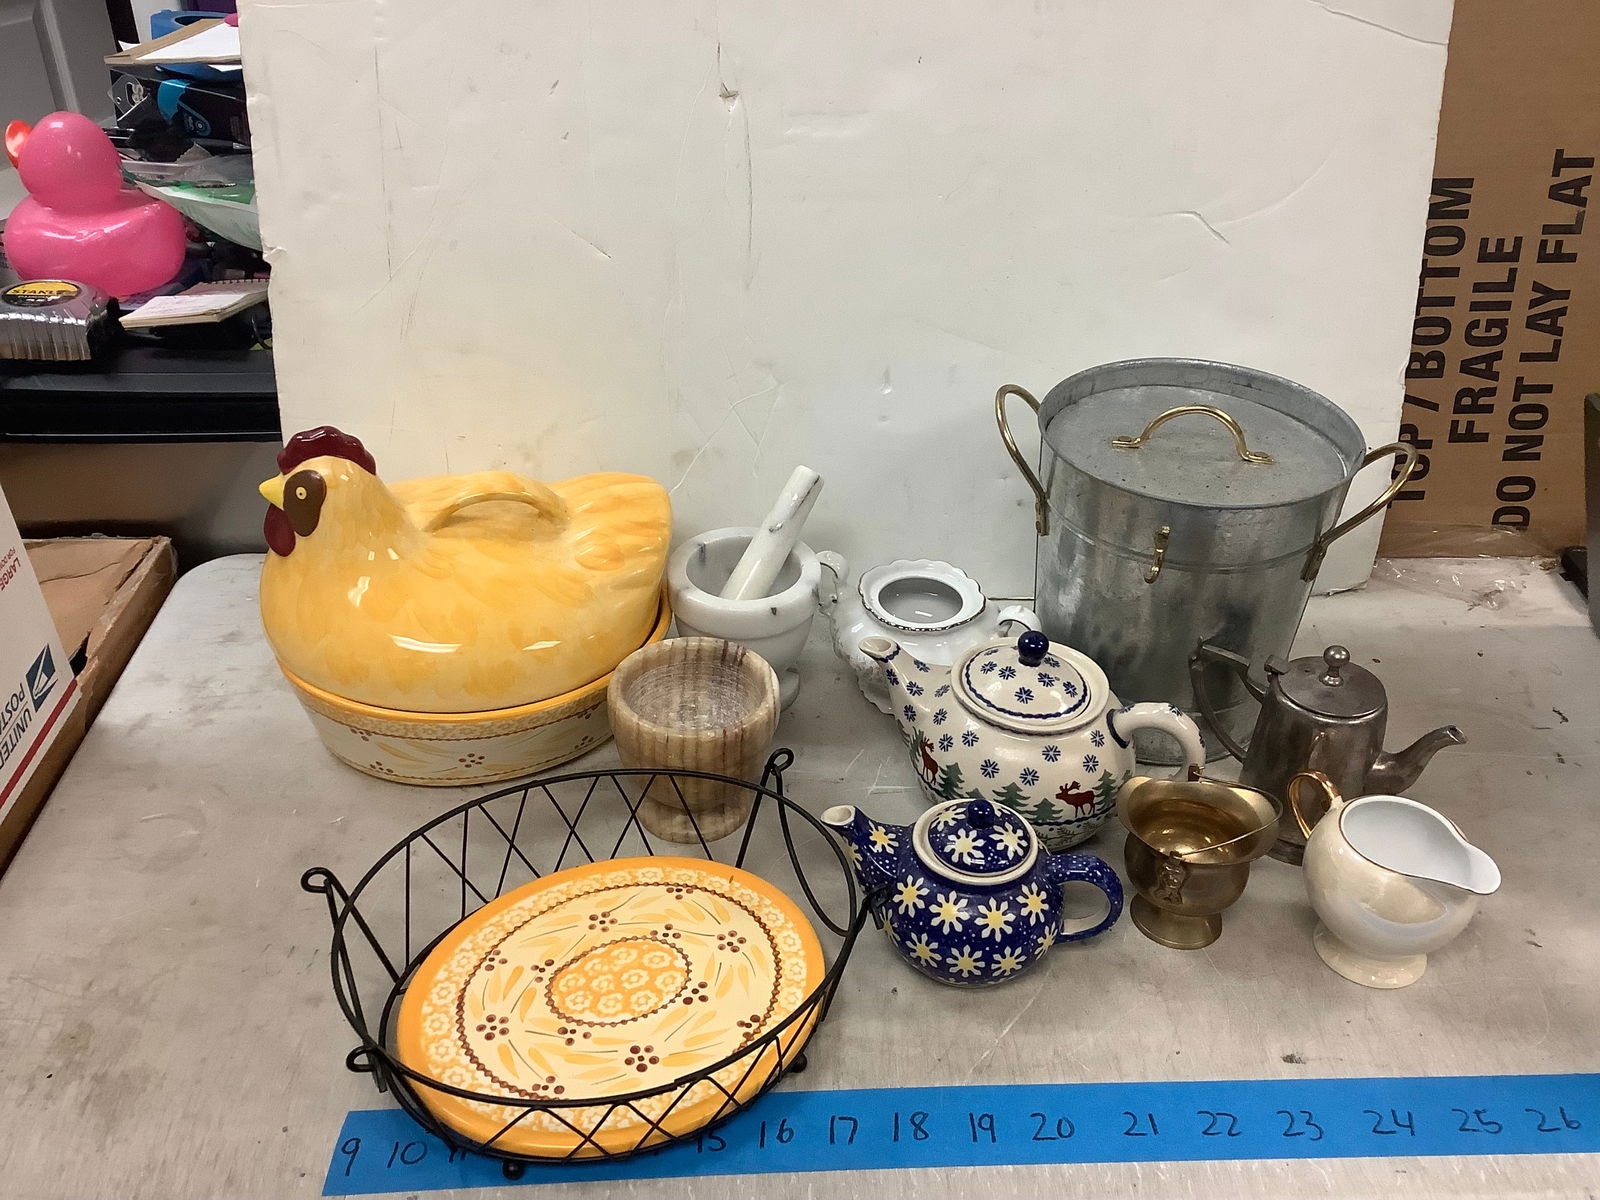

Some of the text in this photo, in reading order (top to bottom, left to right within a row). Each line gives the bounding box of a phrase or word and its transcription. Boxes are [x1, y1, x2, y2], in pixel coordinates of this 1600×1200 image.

[1404, 177, 1475, 379] BOTTOM
[1447, 235, 1524, 444] FRAGILE
[1491, 148, 1596, 532] DO NOT LAY FLAT
[0, 682, 26, 736] POST
[340, 1137, 362, 1177] 9
[386, 1140, 428, 1169] 10
[696, 1127, 728, 1154] 15
[758, 1118, 795, 1149] 16
[829, 1115, 859, 1145] 17
[892, 1111, 931, 1143] 18
[968, 1112, 998, 1144] 19
[1029, 1112, 1075, 1142] 20
[1122, 1111, 1160, 1137] 21
[1197, 1110, 1243, 1137] 22
[1276, 1110, 1324, 1141] 23
[1363, 1108, 1416, 1137] 24
[1451, 1108, 1504, 1135] 25
[1525, 1106, 1582, 1133] 26
